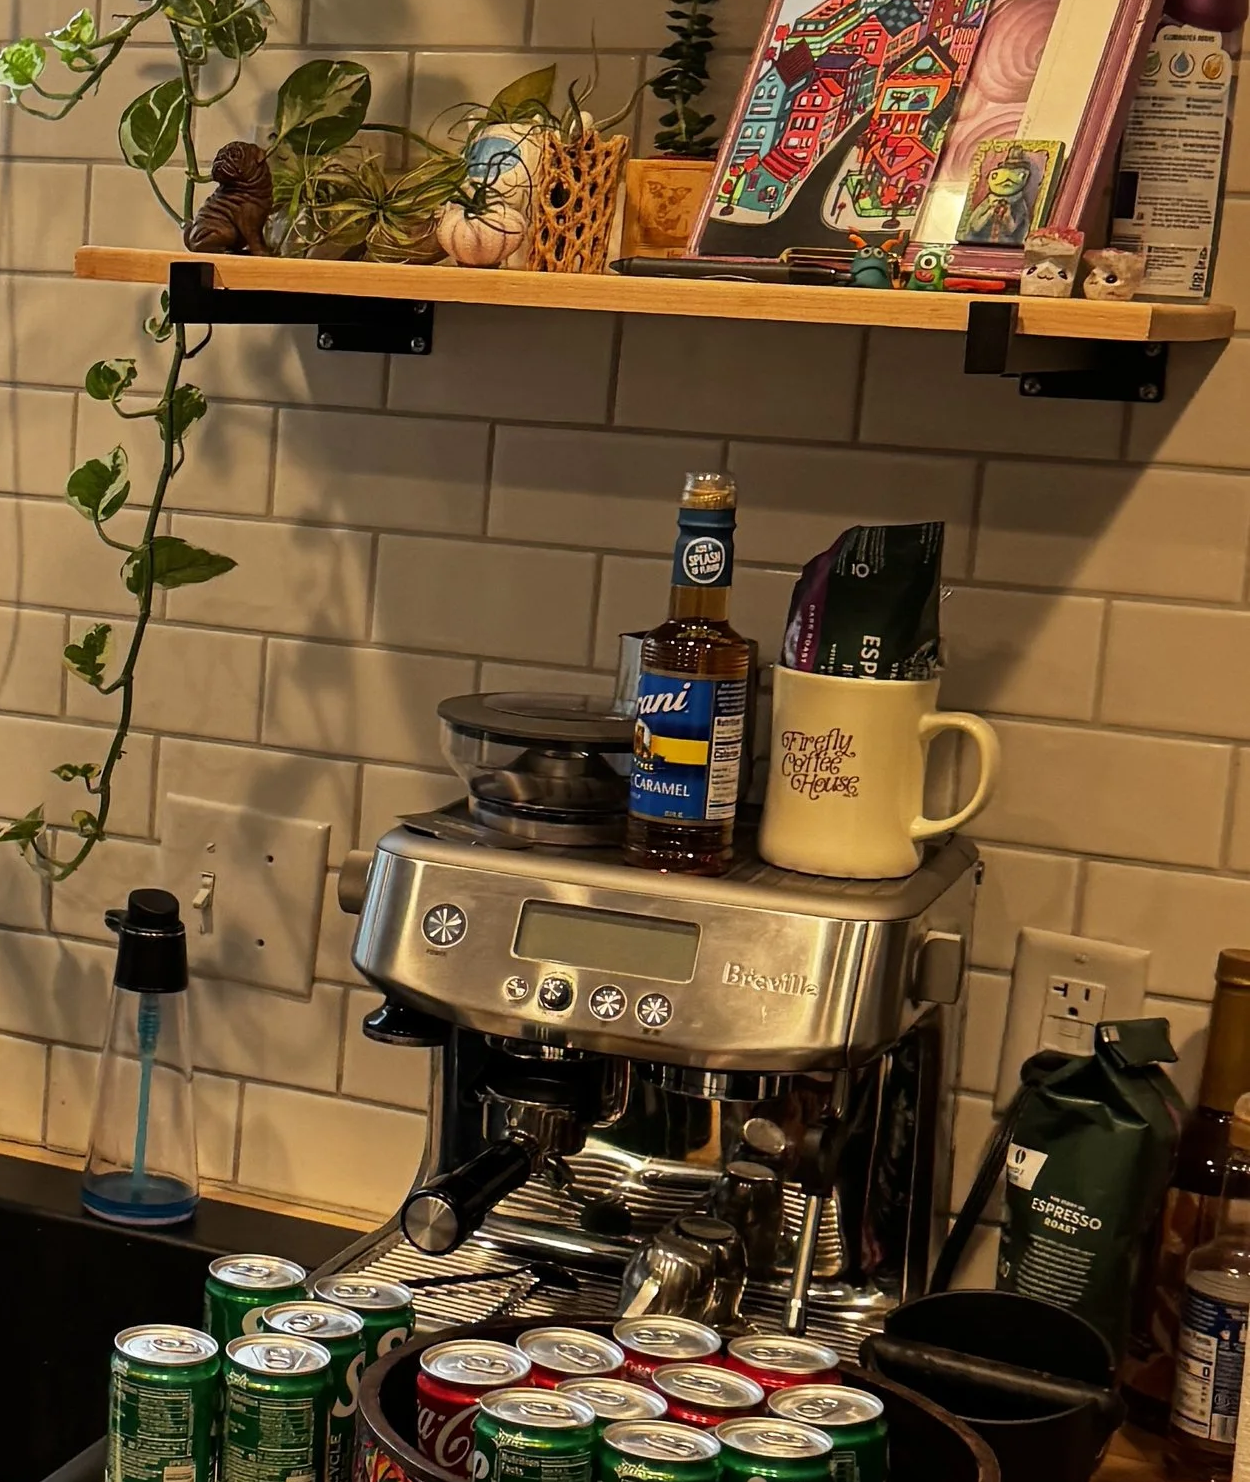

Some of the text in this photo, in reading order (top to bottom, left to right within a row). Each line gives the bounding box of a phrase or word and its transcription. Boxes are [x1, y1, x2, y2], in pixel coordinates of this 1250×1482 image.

[688, 550, 721, 567] SPLASH
[781, 727, 856, 759] Firefly
[781, 750, 843, 777] Coffee
[634, 773, 691, 798] CARAMEL
[790, 773, 860, 801] House
[722, 961, 819, 999] Breville
[1031, 1197, 1103, 1231] ESPRESSO
[1044, 1217, 1078, 1235] ROAST
[501, 1452, 540, 1468] Nutrition
[501, 1461, 524, 1476] Facts
